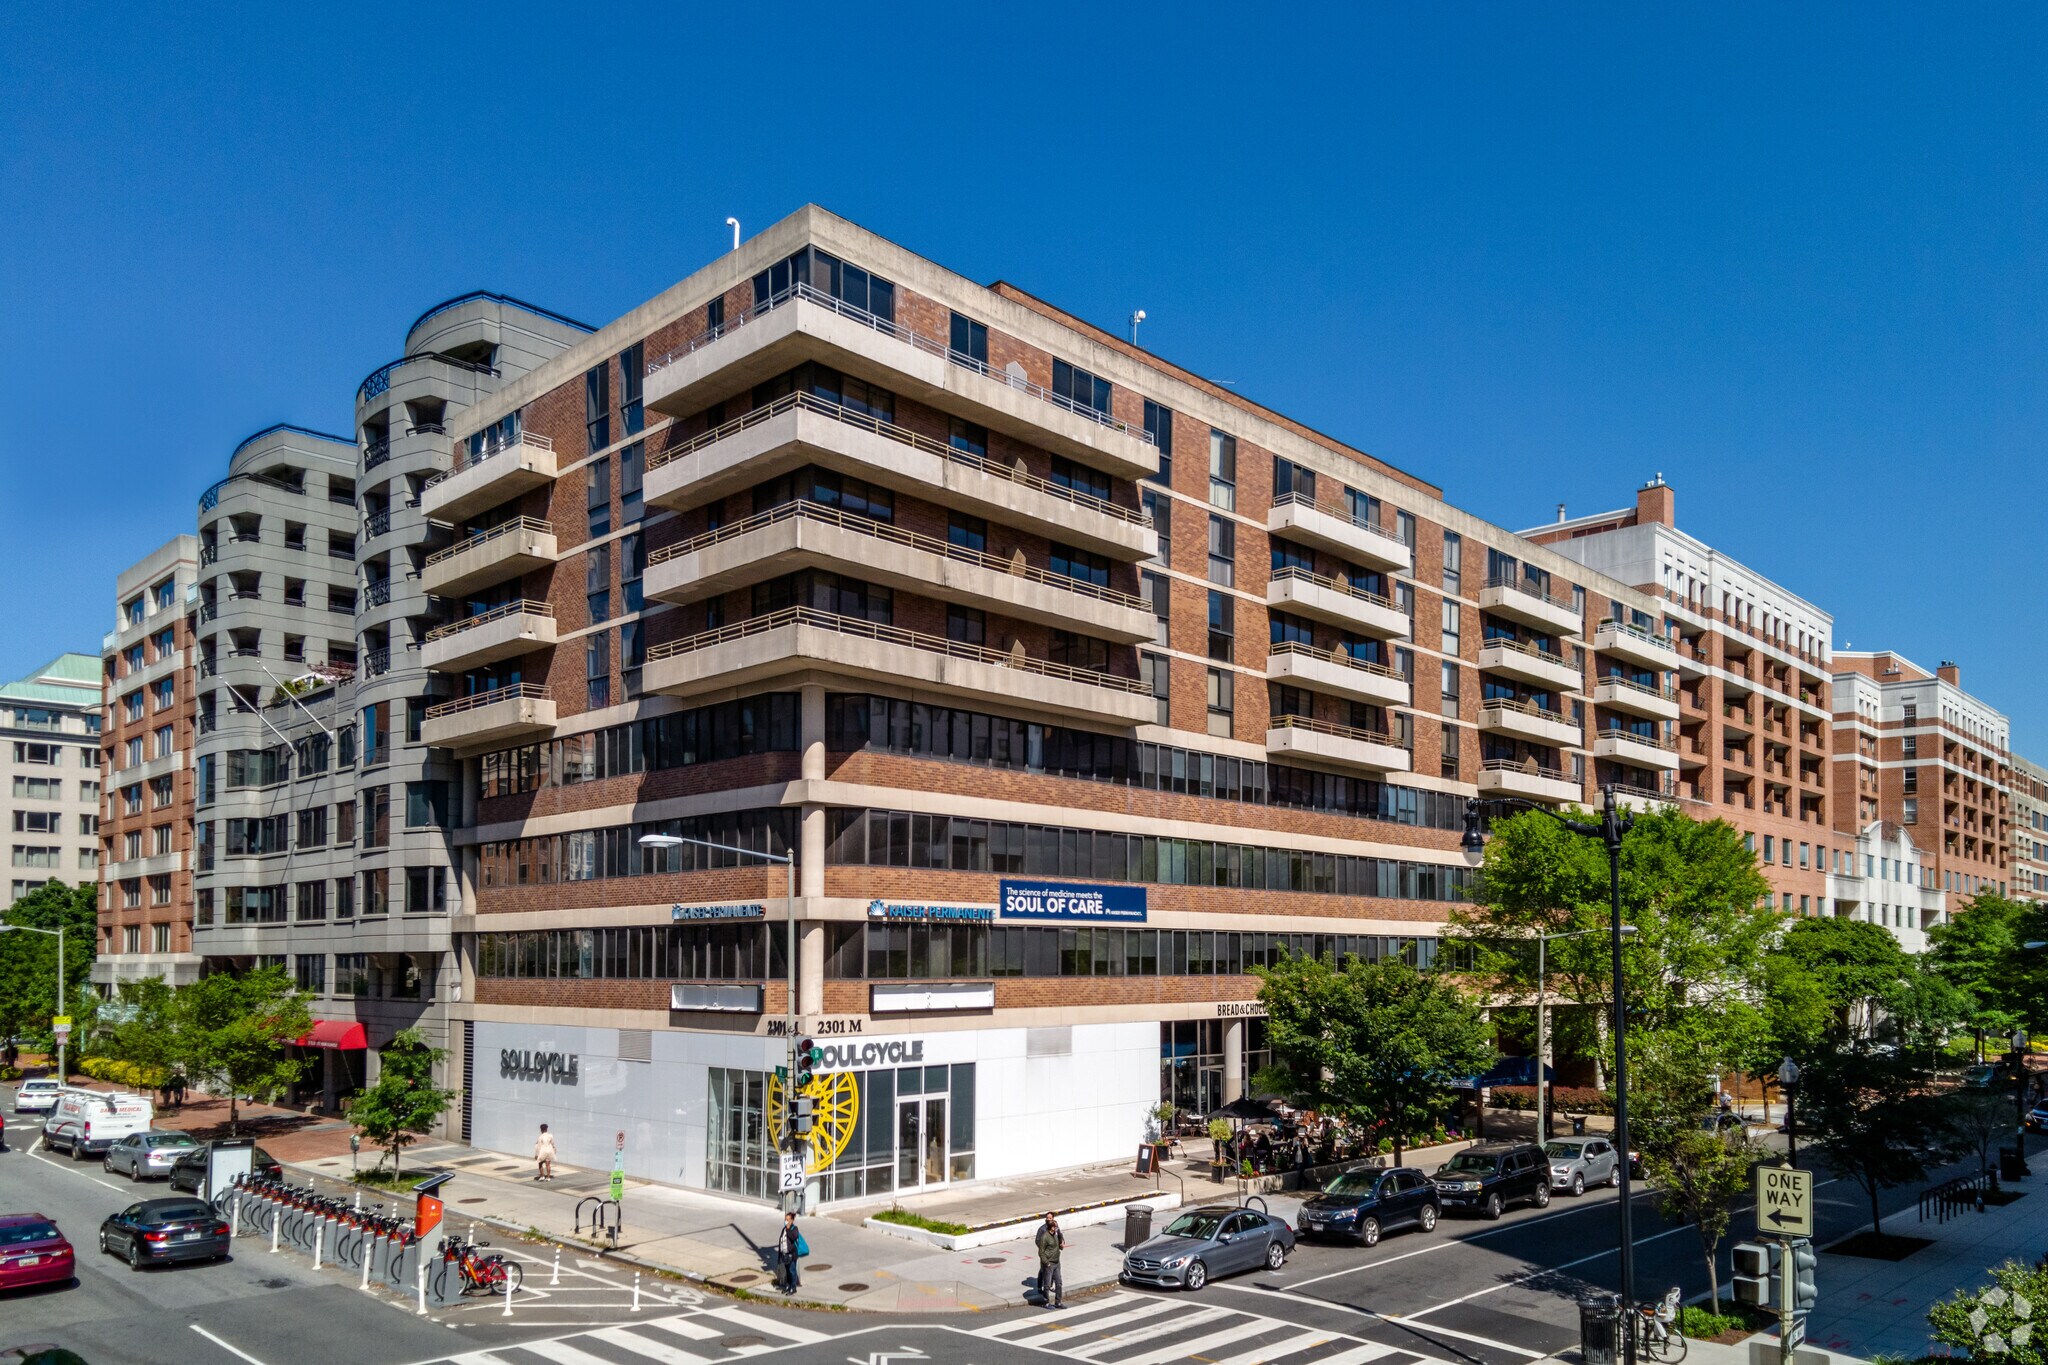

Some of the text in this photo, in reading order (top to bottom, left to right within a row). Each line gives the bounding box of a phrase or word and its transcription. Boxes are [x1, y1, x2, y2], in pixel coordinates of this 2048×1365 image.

[1006, 887, 1103, 900] The science of medicine meets the
[889, 905, 997, 919] KAISER PERMANENTE
[1006, 896, 1104, 914] SOUL OF CARE
[817, 1019, 862, 1034] 2301 M
[501, 1048, 578, 1077] SOULCYCLE
[784, 1172, 802, 1187] 25
[1768, 1173, 1802, 1190] ONE
[1766, 1190, 1803, 1207] WAY
